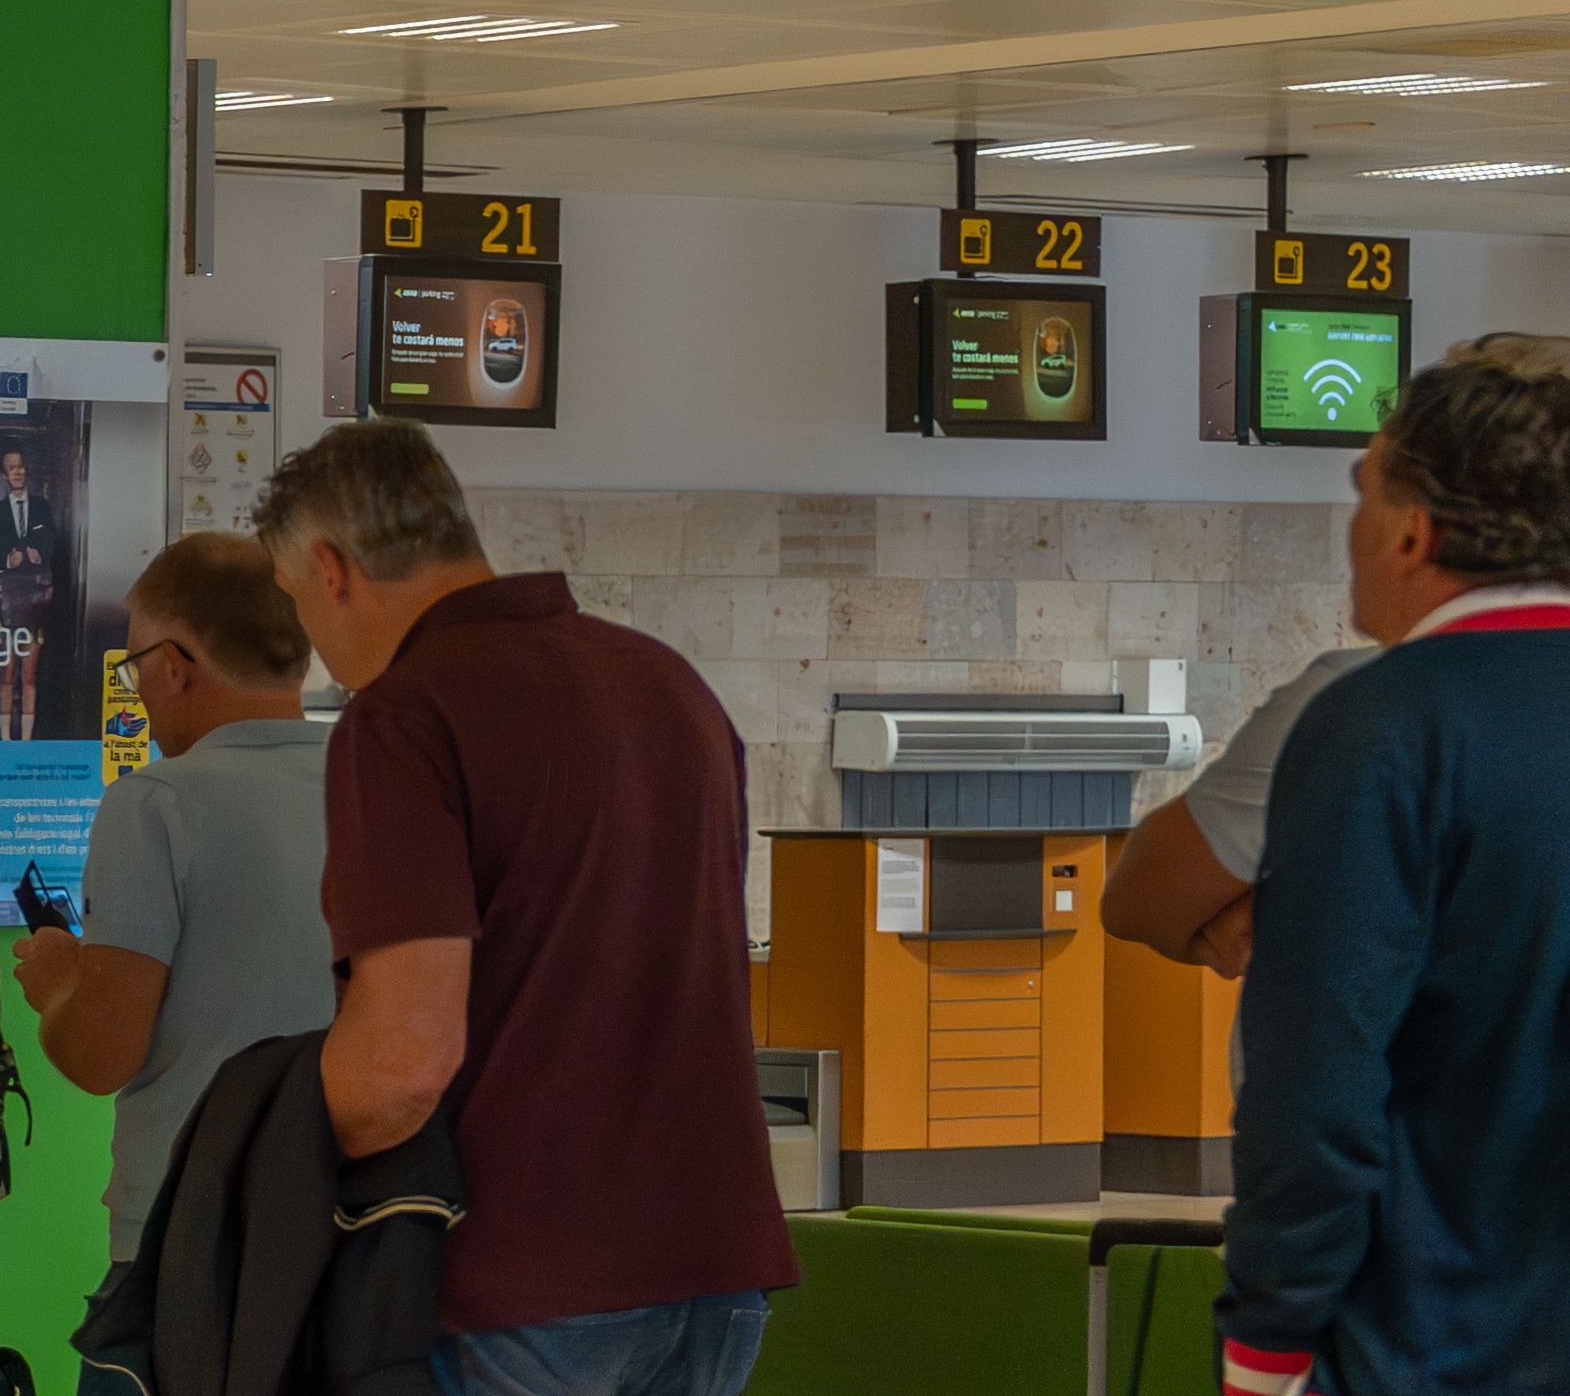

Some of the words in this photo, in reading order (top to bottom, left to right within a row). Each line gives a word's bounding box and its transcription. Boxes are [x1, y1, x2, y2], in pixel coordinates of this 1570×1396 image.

[480, 201, 537, 255] 21
[1035, 219, 1083, 270] 22
[1347, 241, 1392, 291] 23
[109, 749, 120, 762] la
